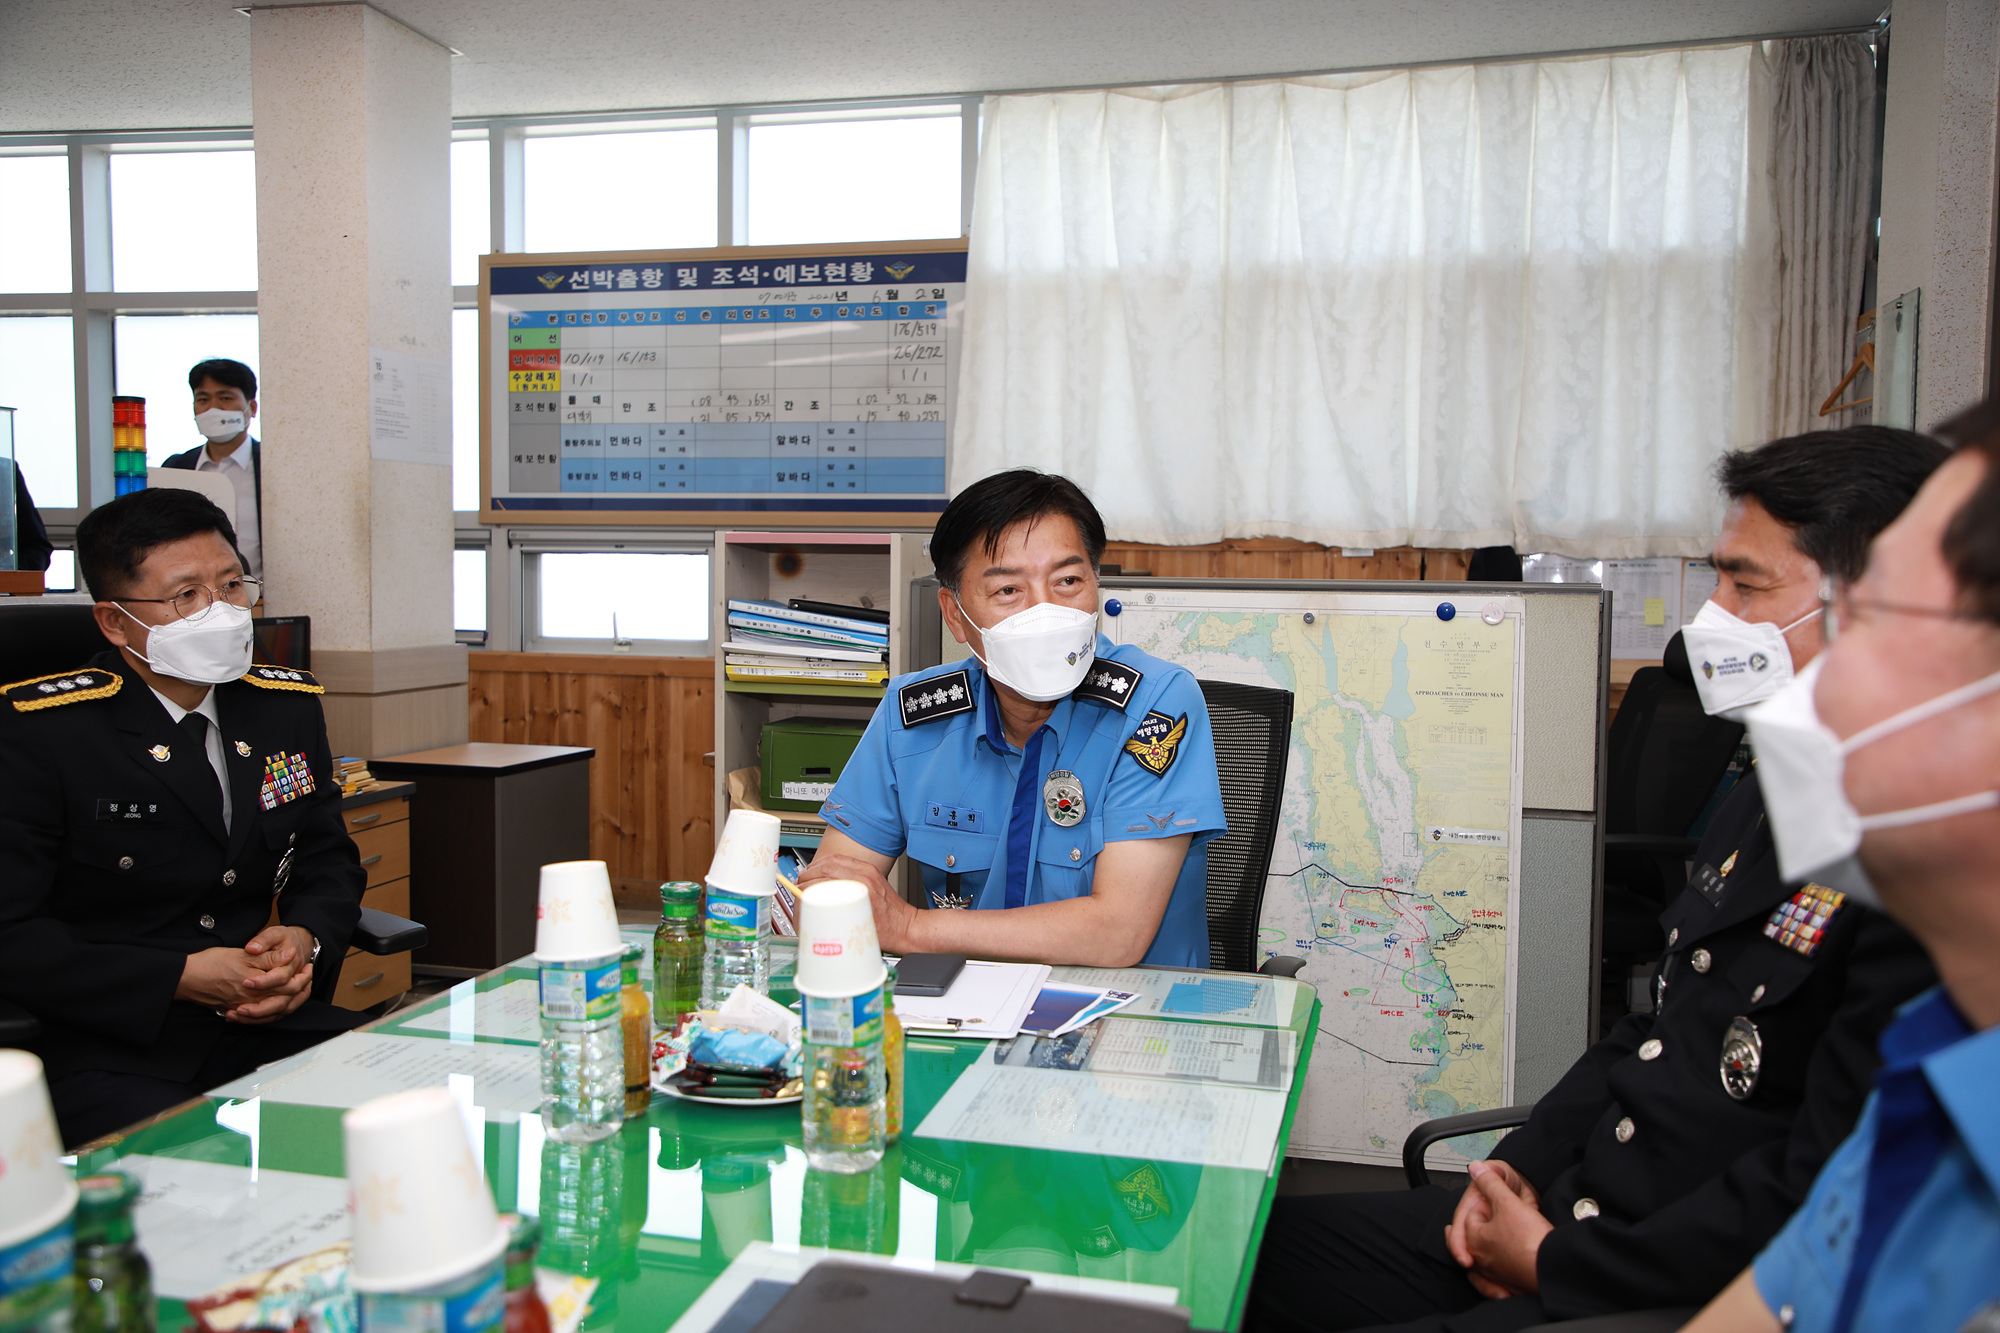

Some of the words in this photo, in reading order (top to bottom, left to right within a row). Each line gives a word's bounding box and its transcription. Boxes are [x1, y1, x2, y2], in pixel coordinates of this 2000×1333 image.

[569, 268, 664, 290] 선박출항
[677, 266, 698, 287] 및
[513, 371, 555, 382] 수상레저
[514, 403, 557, 413] 조석현황
[514, 454, 557, 465] 예보현황
[785, 787, 808, 796] 마니또
